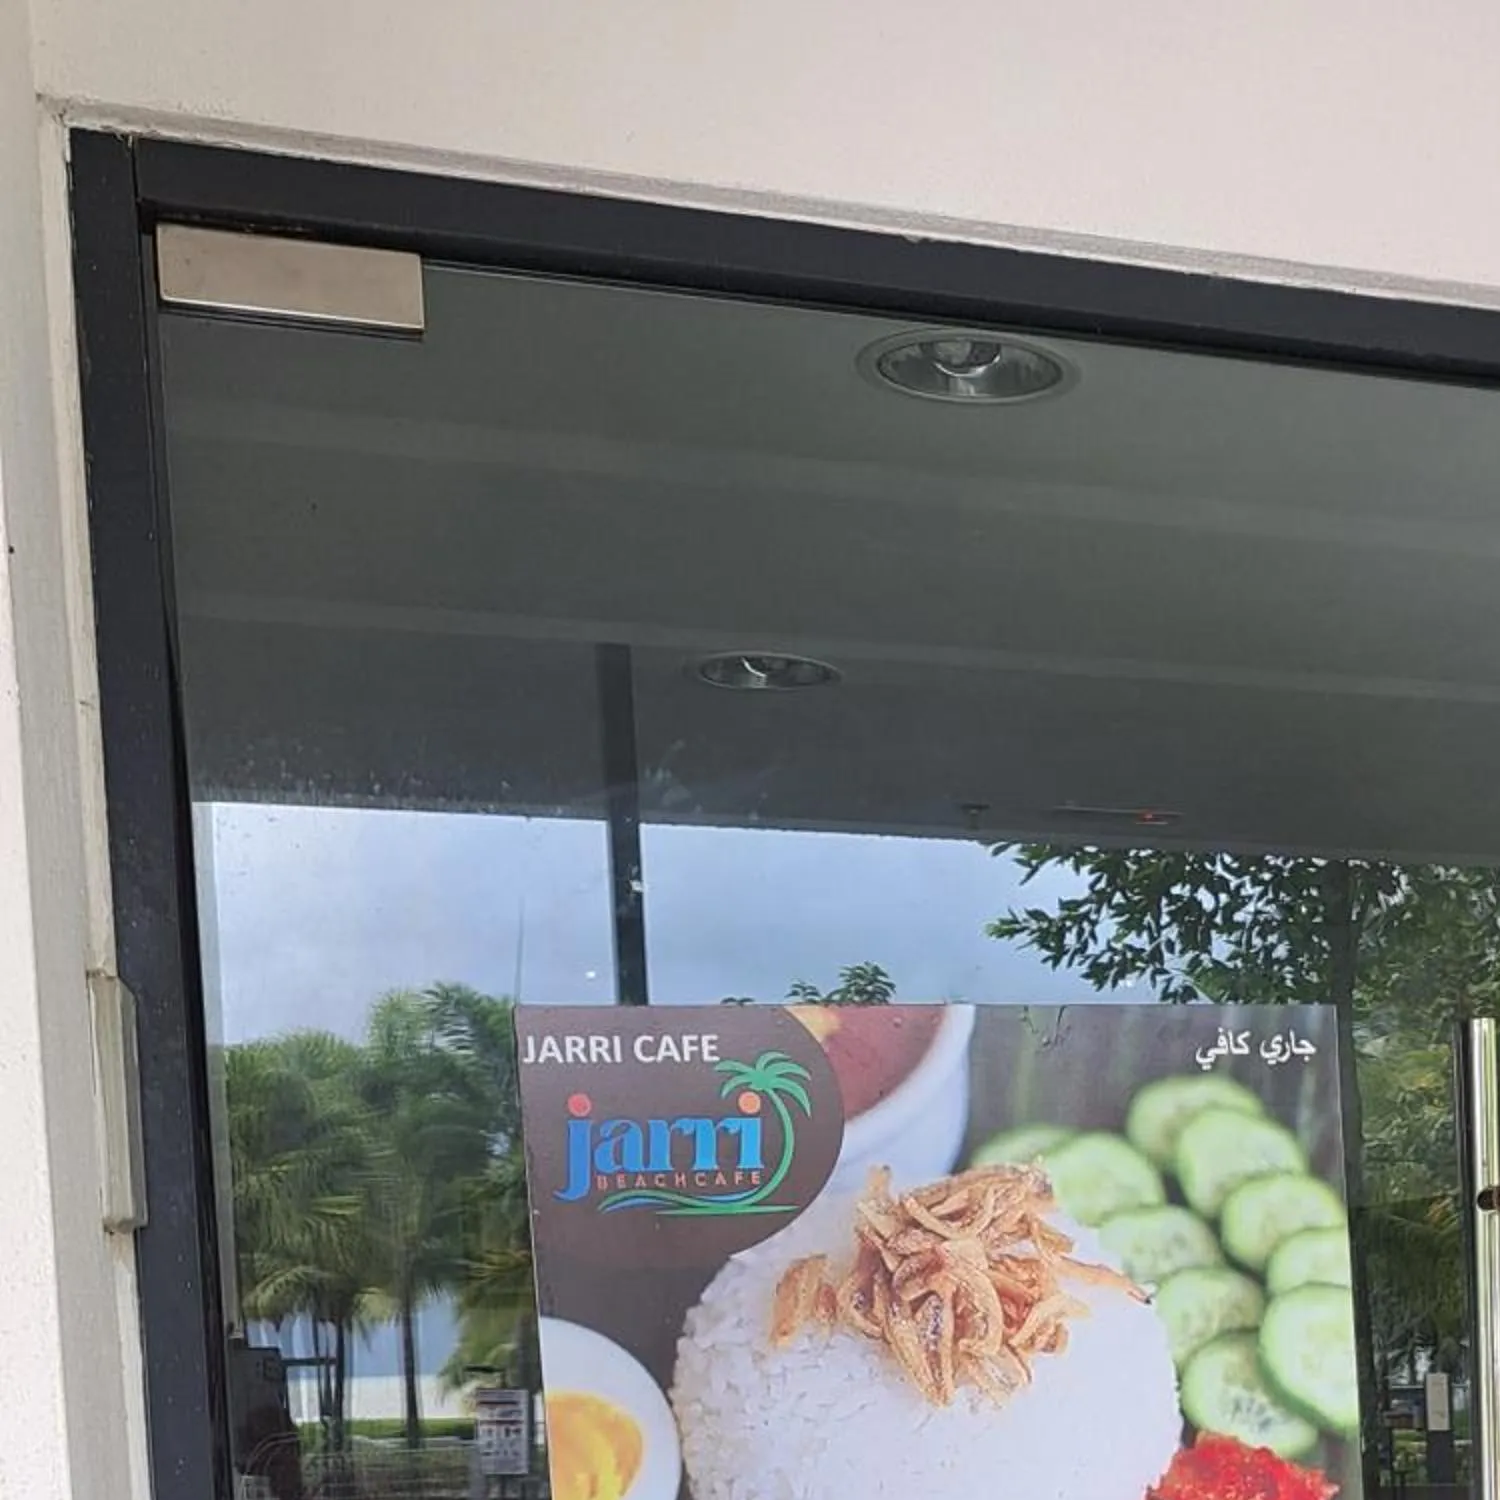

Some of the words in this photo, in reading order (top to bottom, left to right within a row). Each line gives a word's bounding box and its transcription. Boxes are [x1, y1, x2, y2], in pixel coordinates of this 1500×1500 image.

[522, 1034, 622, 1064] JARRI
[633, 1034, 721, 1063] CAFE
[1195, 1026, 1252, 1070] كافي
[1259, 1028, 1317, 1065] جاري
[553, 1092, 766, 1201] jarri
